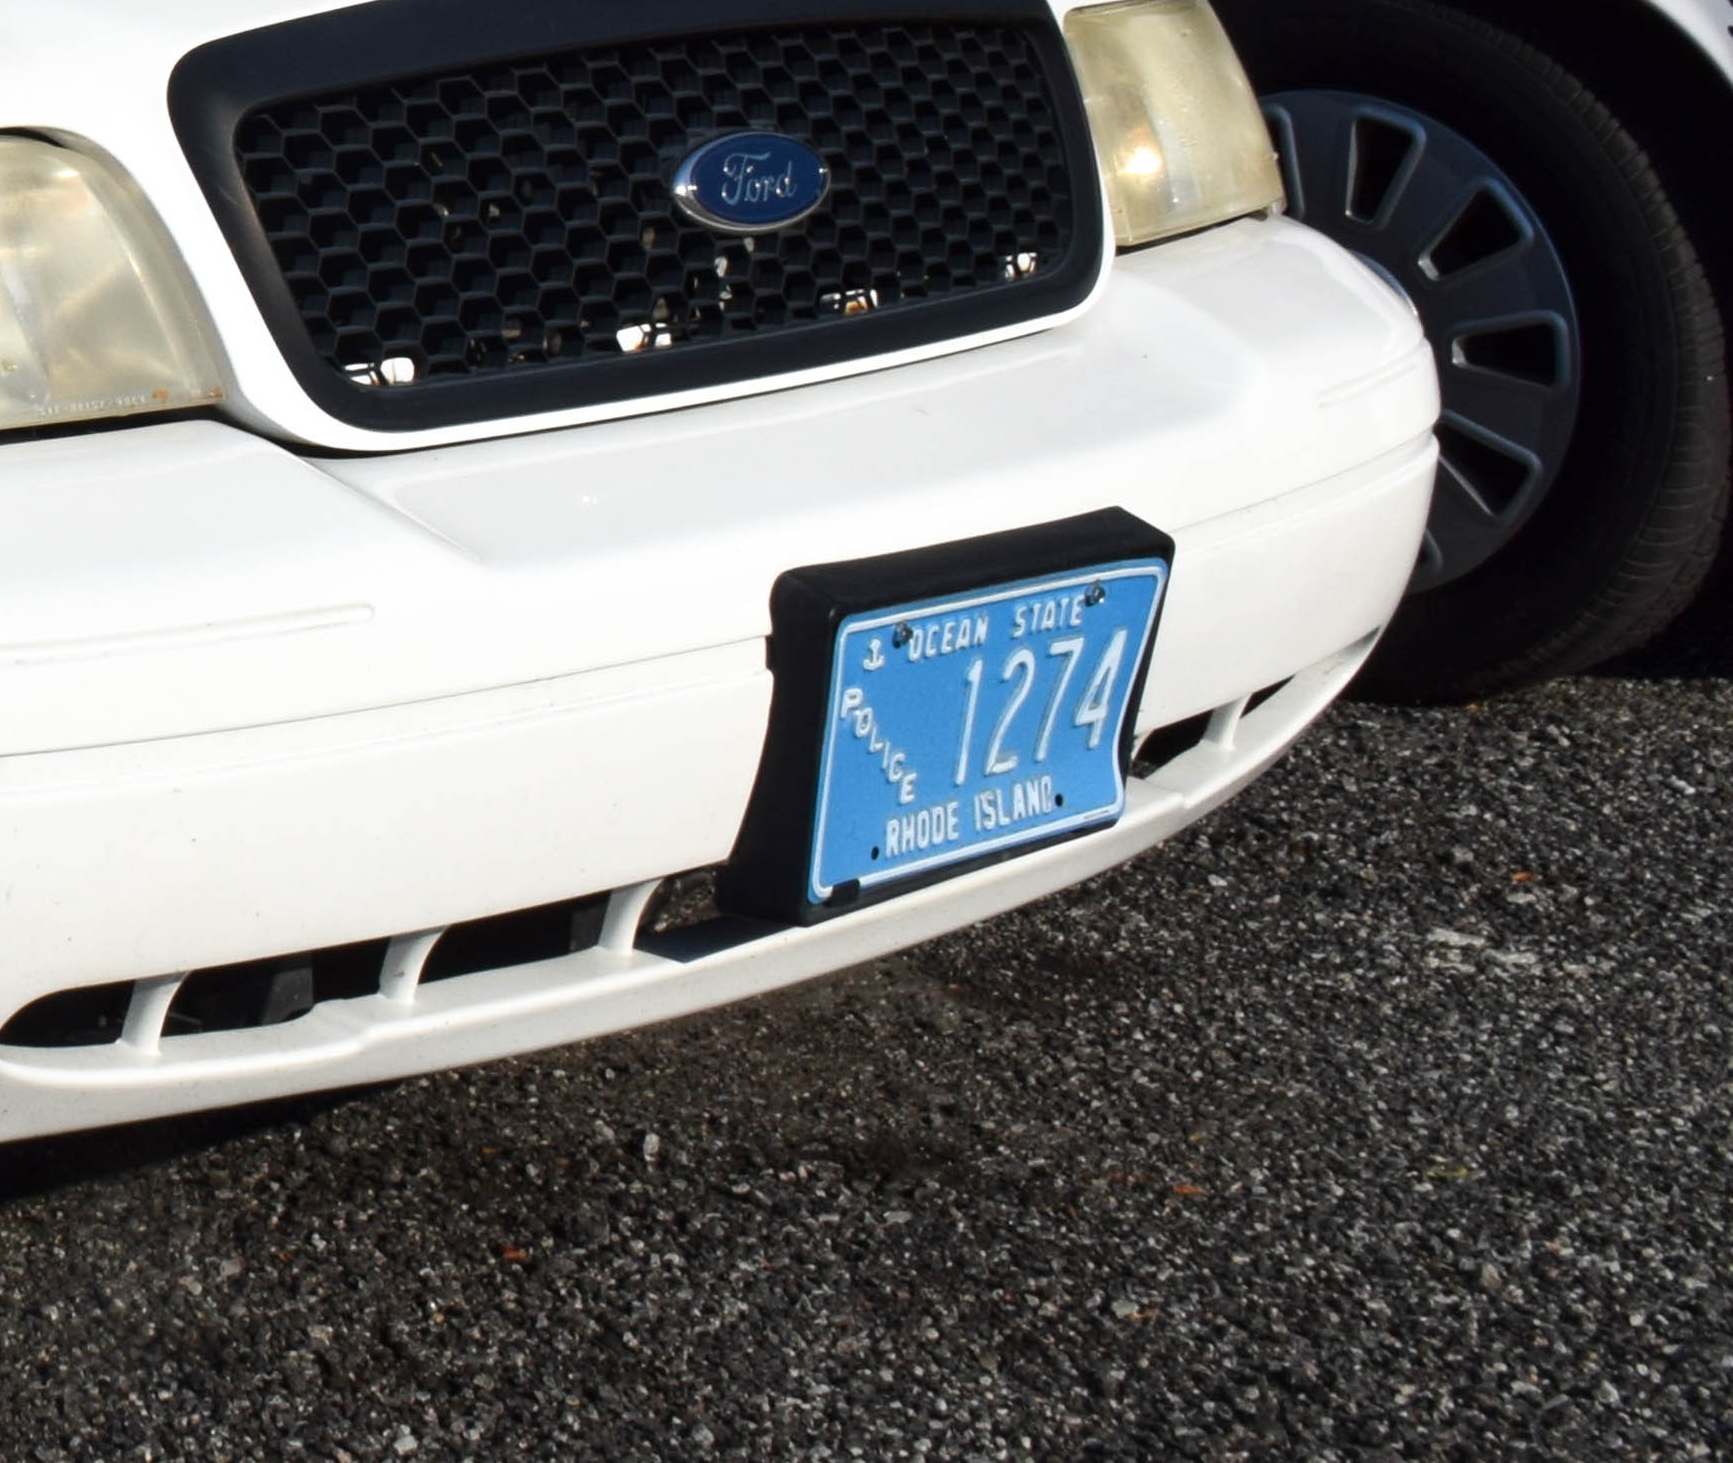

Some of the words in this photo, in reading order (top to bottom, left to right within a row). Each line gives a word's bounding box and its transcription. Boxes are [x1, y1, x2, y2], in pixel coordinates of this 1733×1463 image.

[721, 151, 797, 206] Ford
[907, 613, 989, 663] OCEAN
[1012, 593, 1084, 634] STATE
[840, 687, 917, 806] POLICE
[954, 629, 1128, 788] 1274
[884, 800, 961, 859] RHODE
[973, 775, 1055, 832] ISLAND
